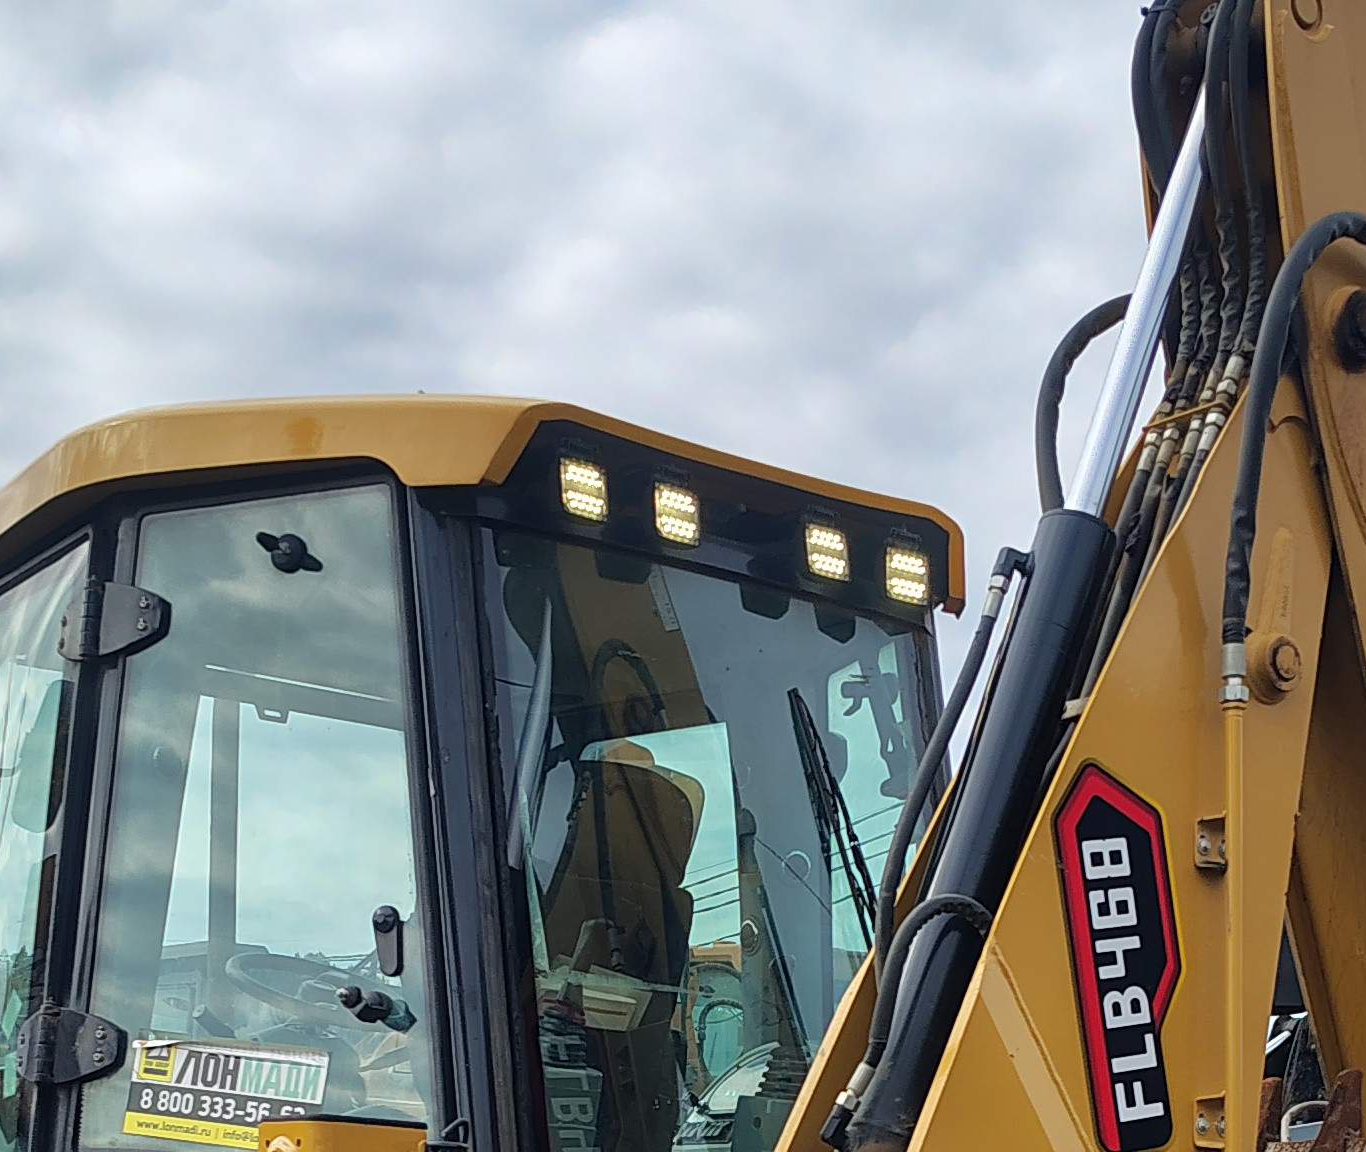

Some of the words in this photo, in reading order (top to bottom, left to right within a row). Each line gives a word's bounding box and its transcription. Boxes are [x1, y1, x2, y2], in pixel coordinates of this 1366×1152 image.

[1081, 835, 1165, 1123] FLB468
[174, 1050, 323, 1100] ЛОНМАДИ
[139, 1088, 154, 1110] 8
[156, 1090, 194, 1115] 800
[136, 1118, 212, 1138] www.lonmadi.ru
[222, 1128, 259, 1143] info@lo
